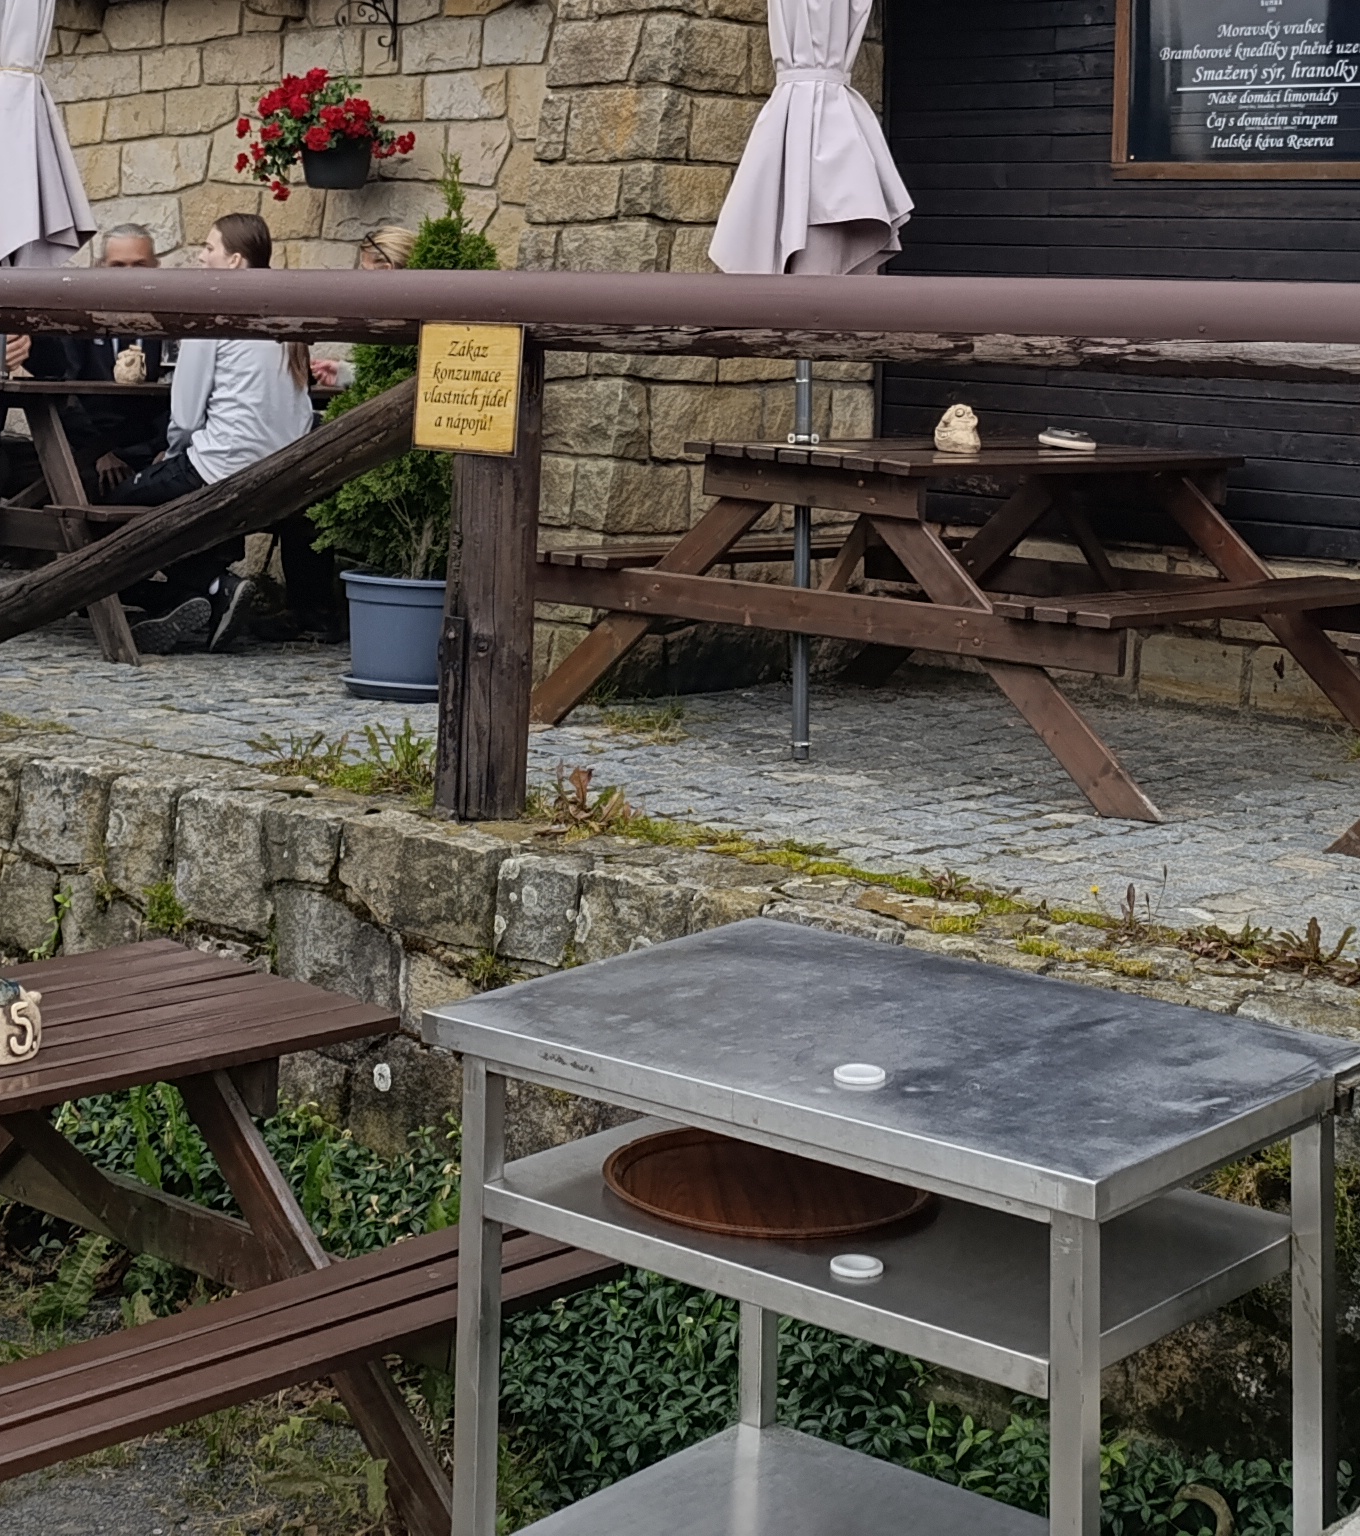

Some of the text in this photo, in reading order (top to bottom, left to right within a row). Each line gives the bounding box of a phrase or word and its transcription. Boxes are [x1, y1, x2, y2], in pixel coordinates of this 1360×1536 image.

[1217, 19, 1325, 40] Moravský vrabec
[1159, 44, 1231, 61] Bramborové
[1235, 41, 1288, 60] knedlíky
[1289, 40, 1334, 60] plněné
[1192, 60, 1358, 85] Smažený sýr, hranolky
[1207, 88, 1339, 105] Naše domácí limonády
[1206, 112, 1338, 131] Čaj s domácím sirupem
[1211, 134, 1334, 151] Italská káva Reserva
[448, 339, 489, 361] Zákaz
[433, 362, 501, 384] konzumace
[423, 385, 512, 412] vlastních jídel
[434, 413, 493, 436] a nápojů!
